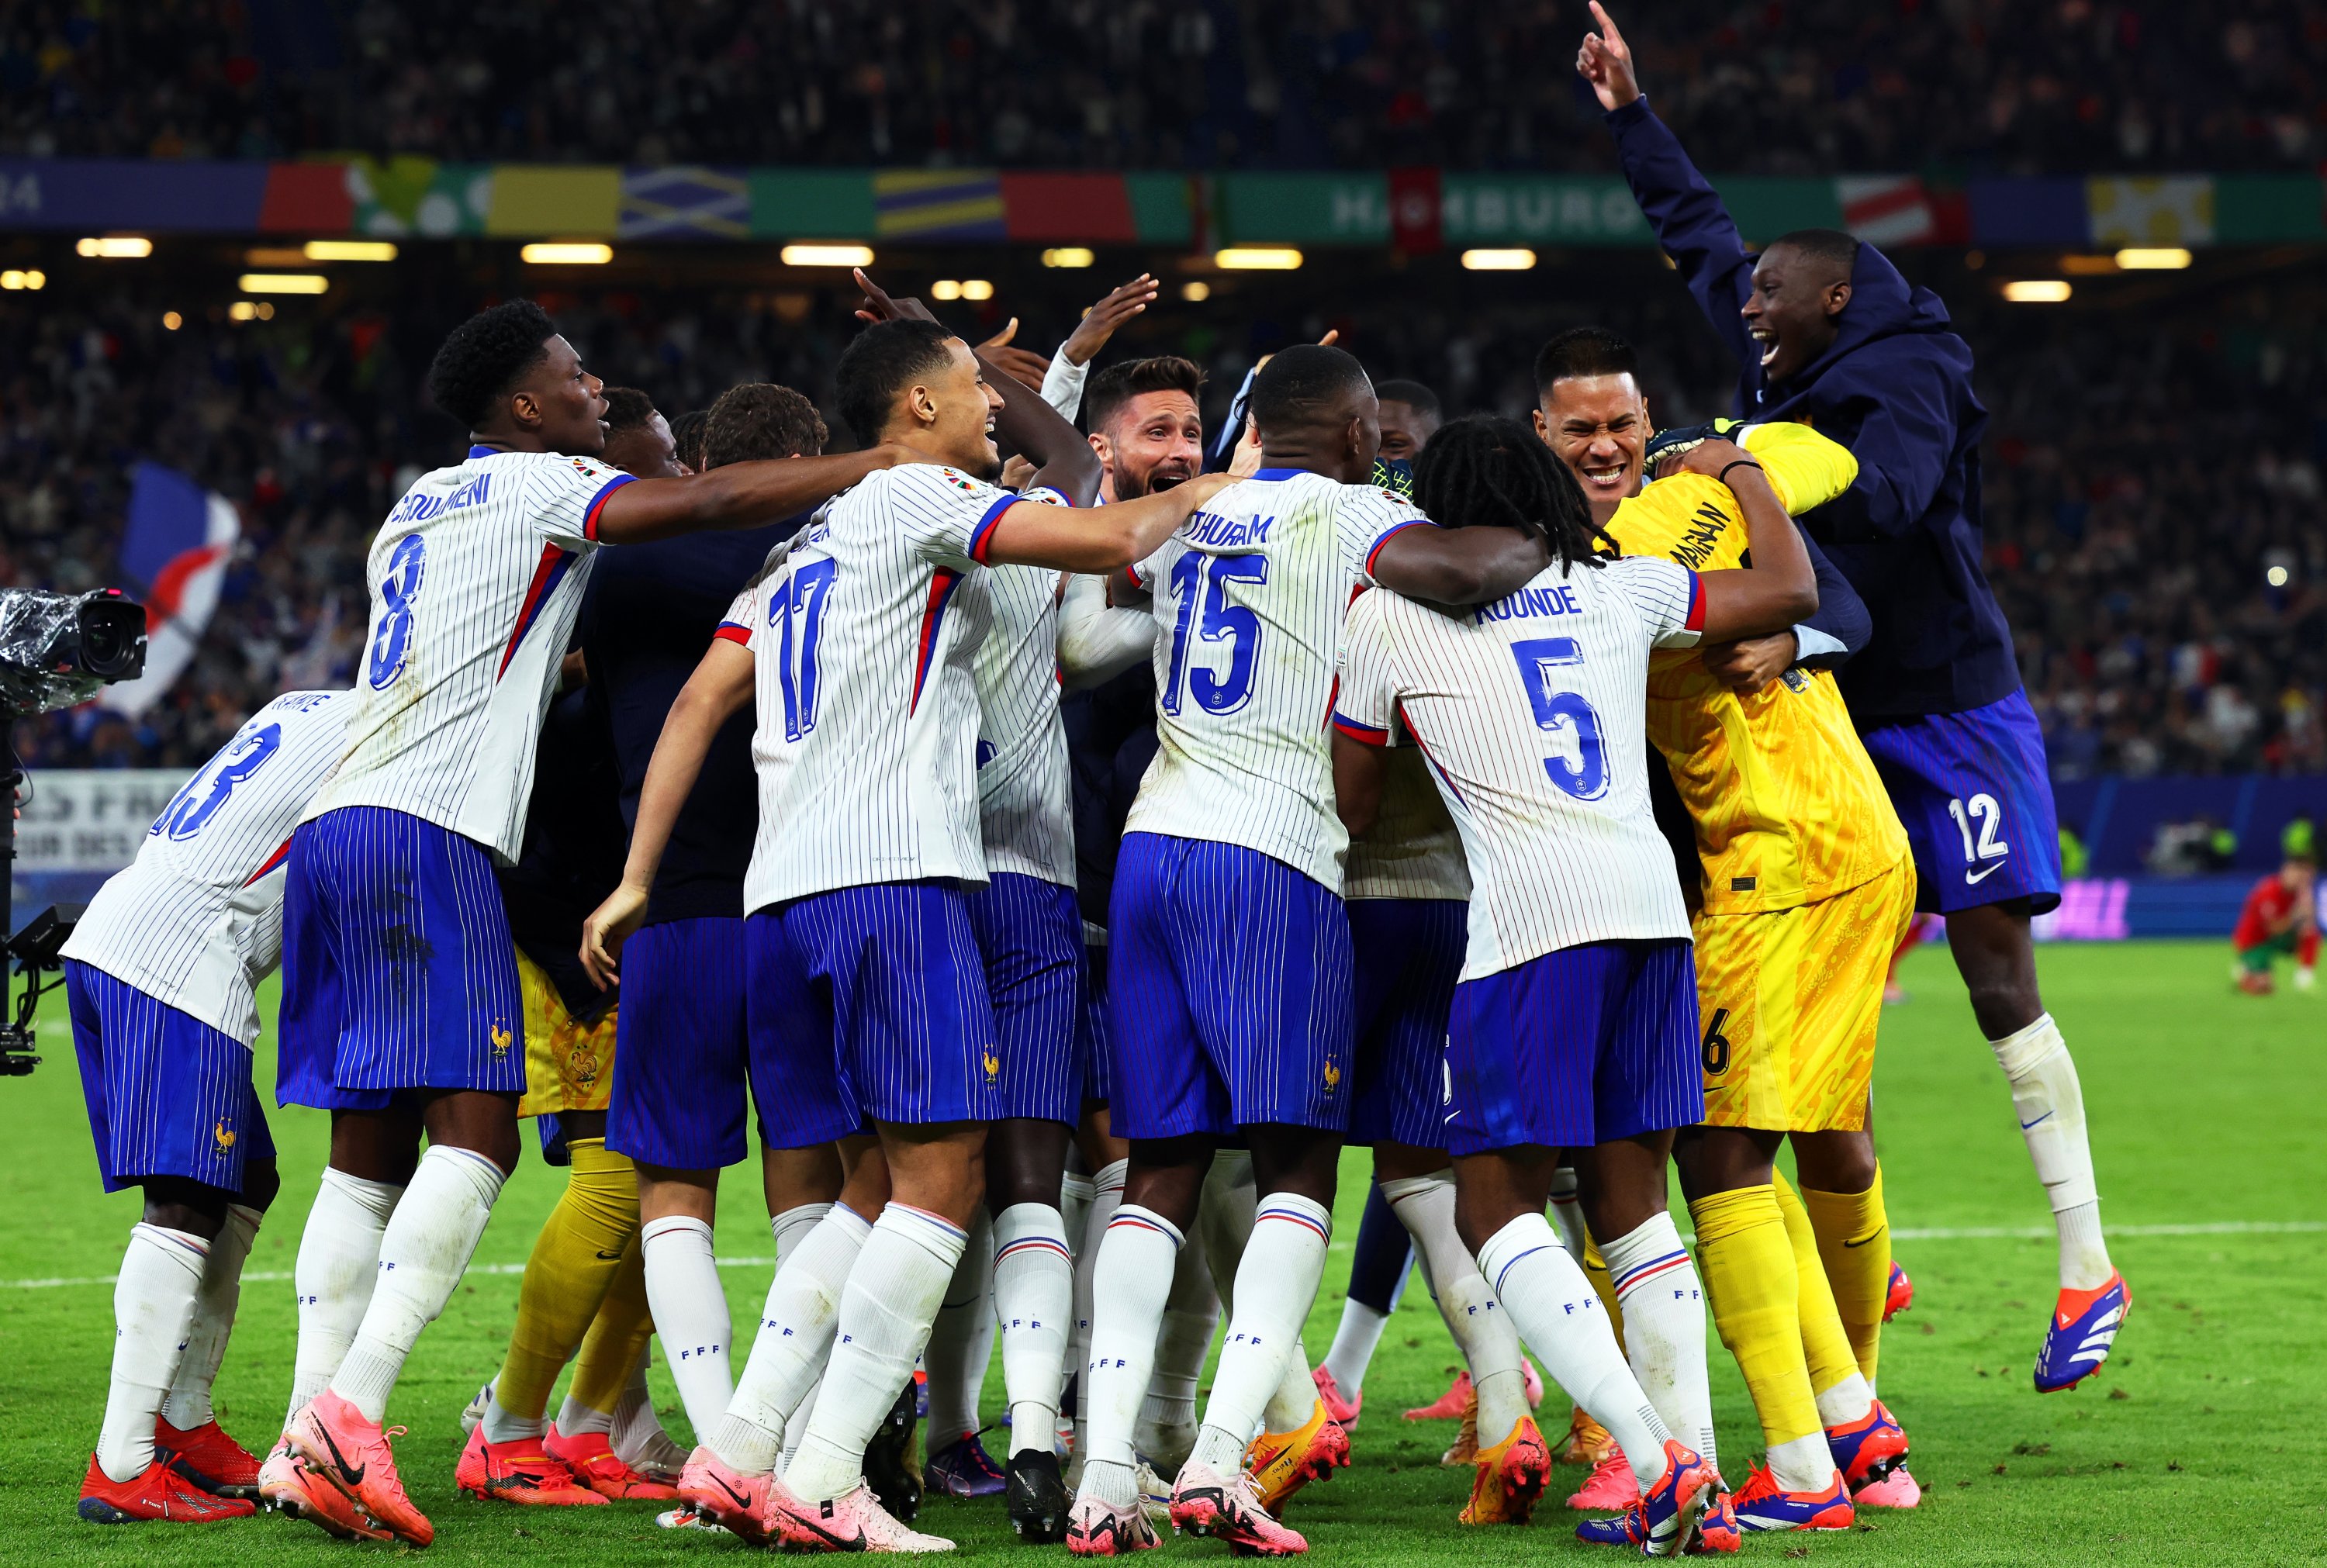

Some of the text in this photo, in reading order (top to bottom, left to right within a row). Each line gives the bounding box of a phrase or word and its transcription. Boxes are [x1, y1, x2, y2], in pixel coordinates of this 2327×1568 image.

[1331, 188, 1640, 231] HBURG
[1183, 511, 1275, 546] THURAM
[369, 534, 426, 691] 8
[769, 556, 838, 743] 17
[1162, 551, 1269, 717] 15
[149, 722, 280, 841] 13
[1511, 637, 1610, 801] 5
[1948, 793, 2009, 862] 12
